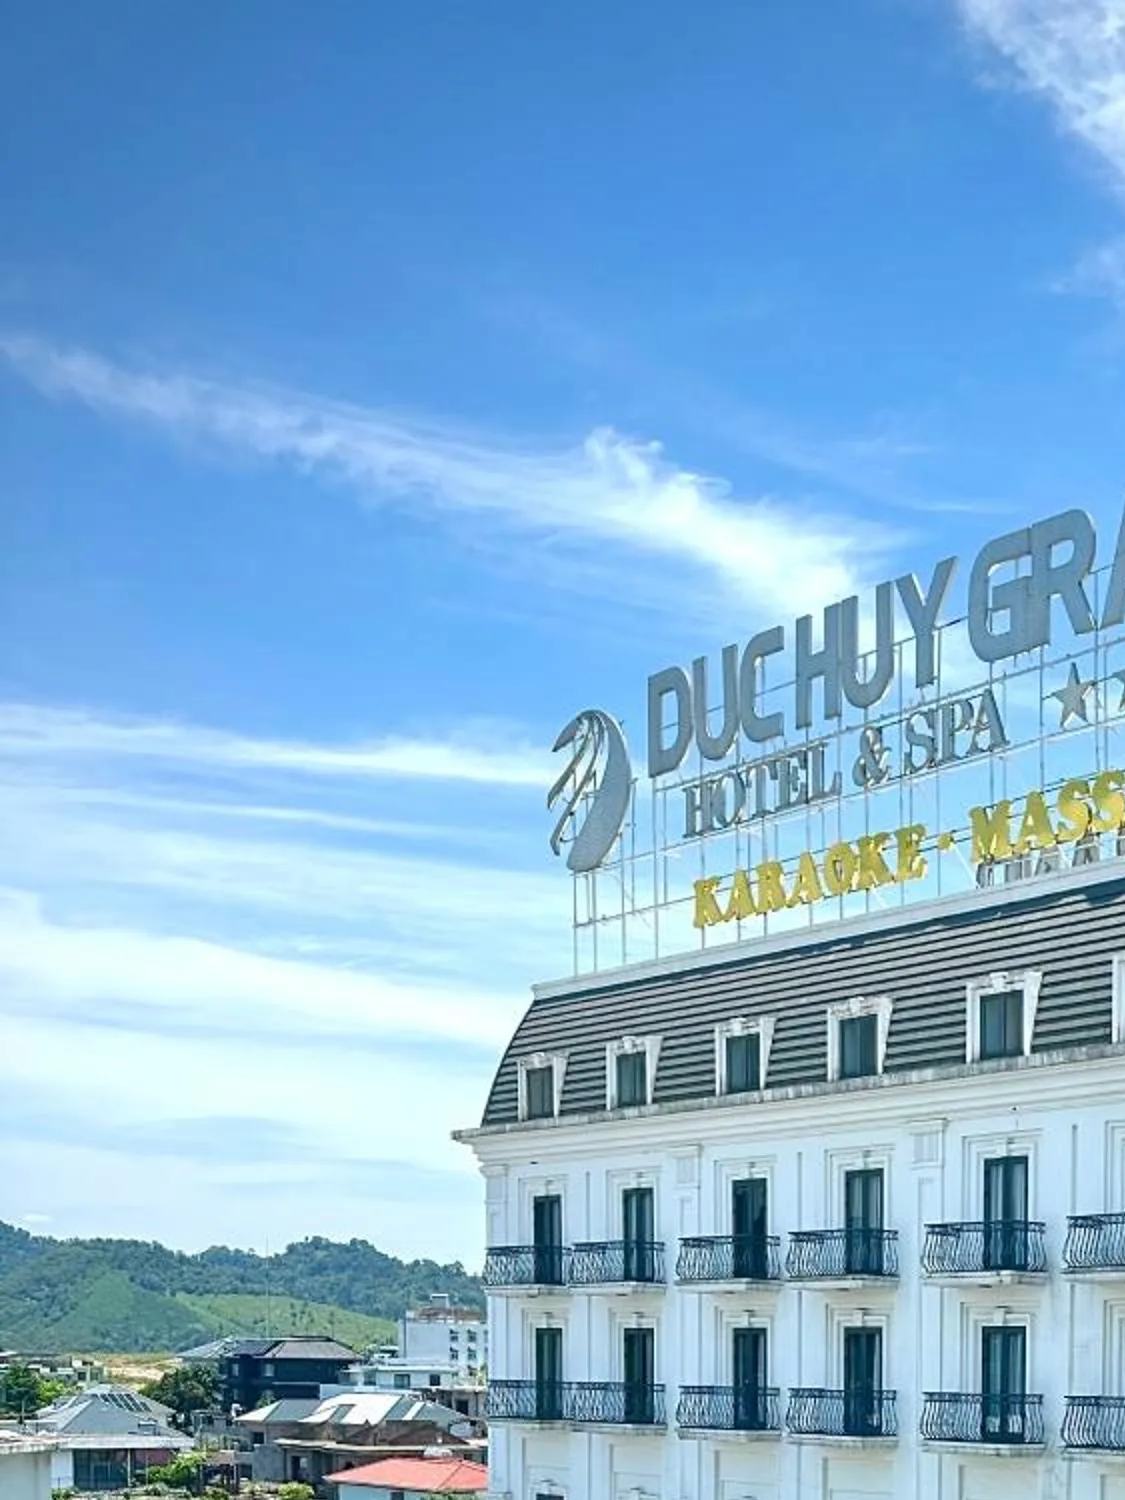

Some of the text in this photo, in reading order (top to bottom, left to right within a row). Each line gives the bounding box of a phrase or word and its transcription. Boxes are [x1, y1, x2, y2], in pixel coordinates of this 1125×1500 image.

[648, 625, 785, 779] DUC
[795, 555, 958, 731] HUY
[682, 687, 1011, 838] HOTEL & SPA
[693, 823, 928, 928] KARAOKE
